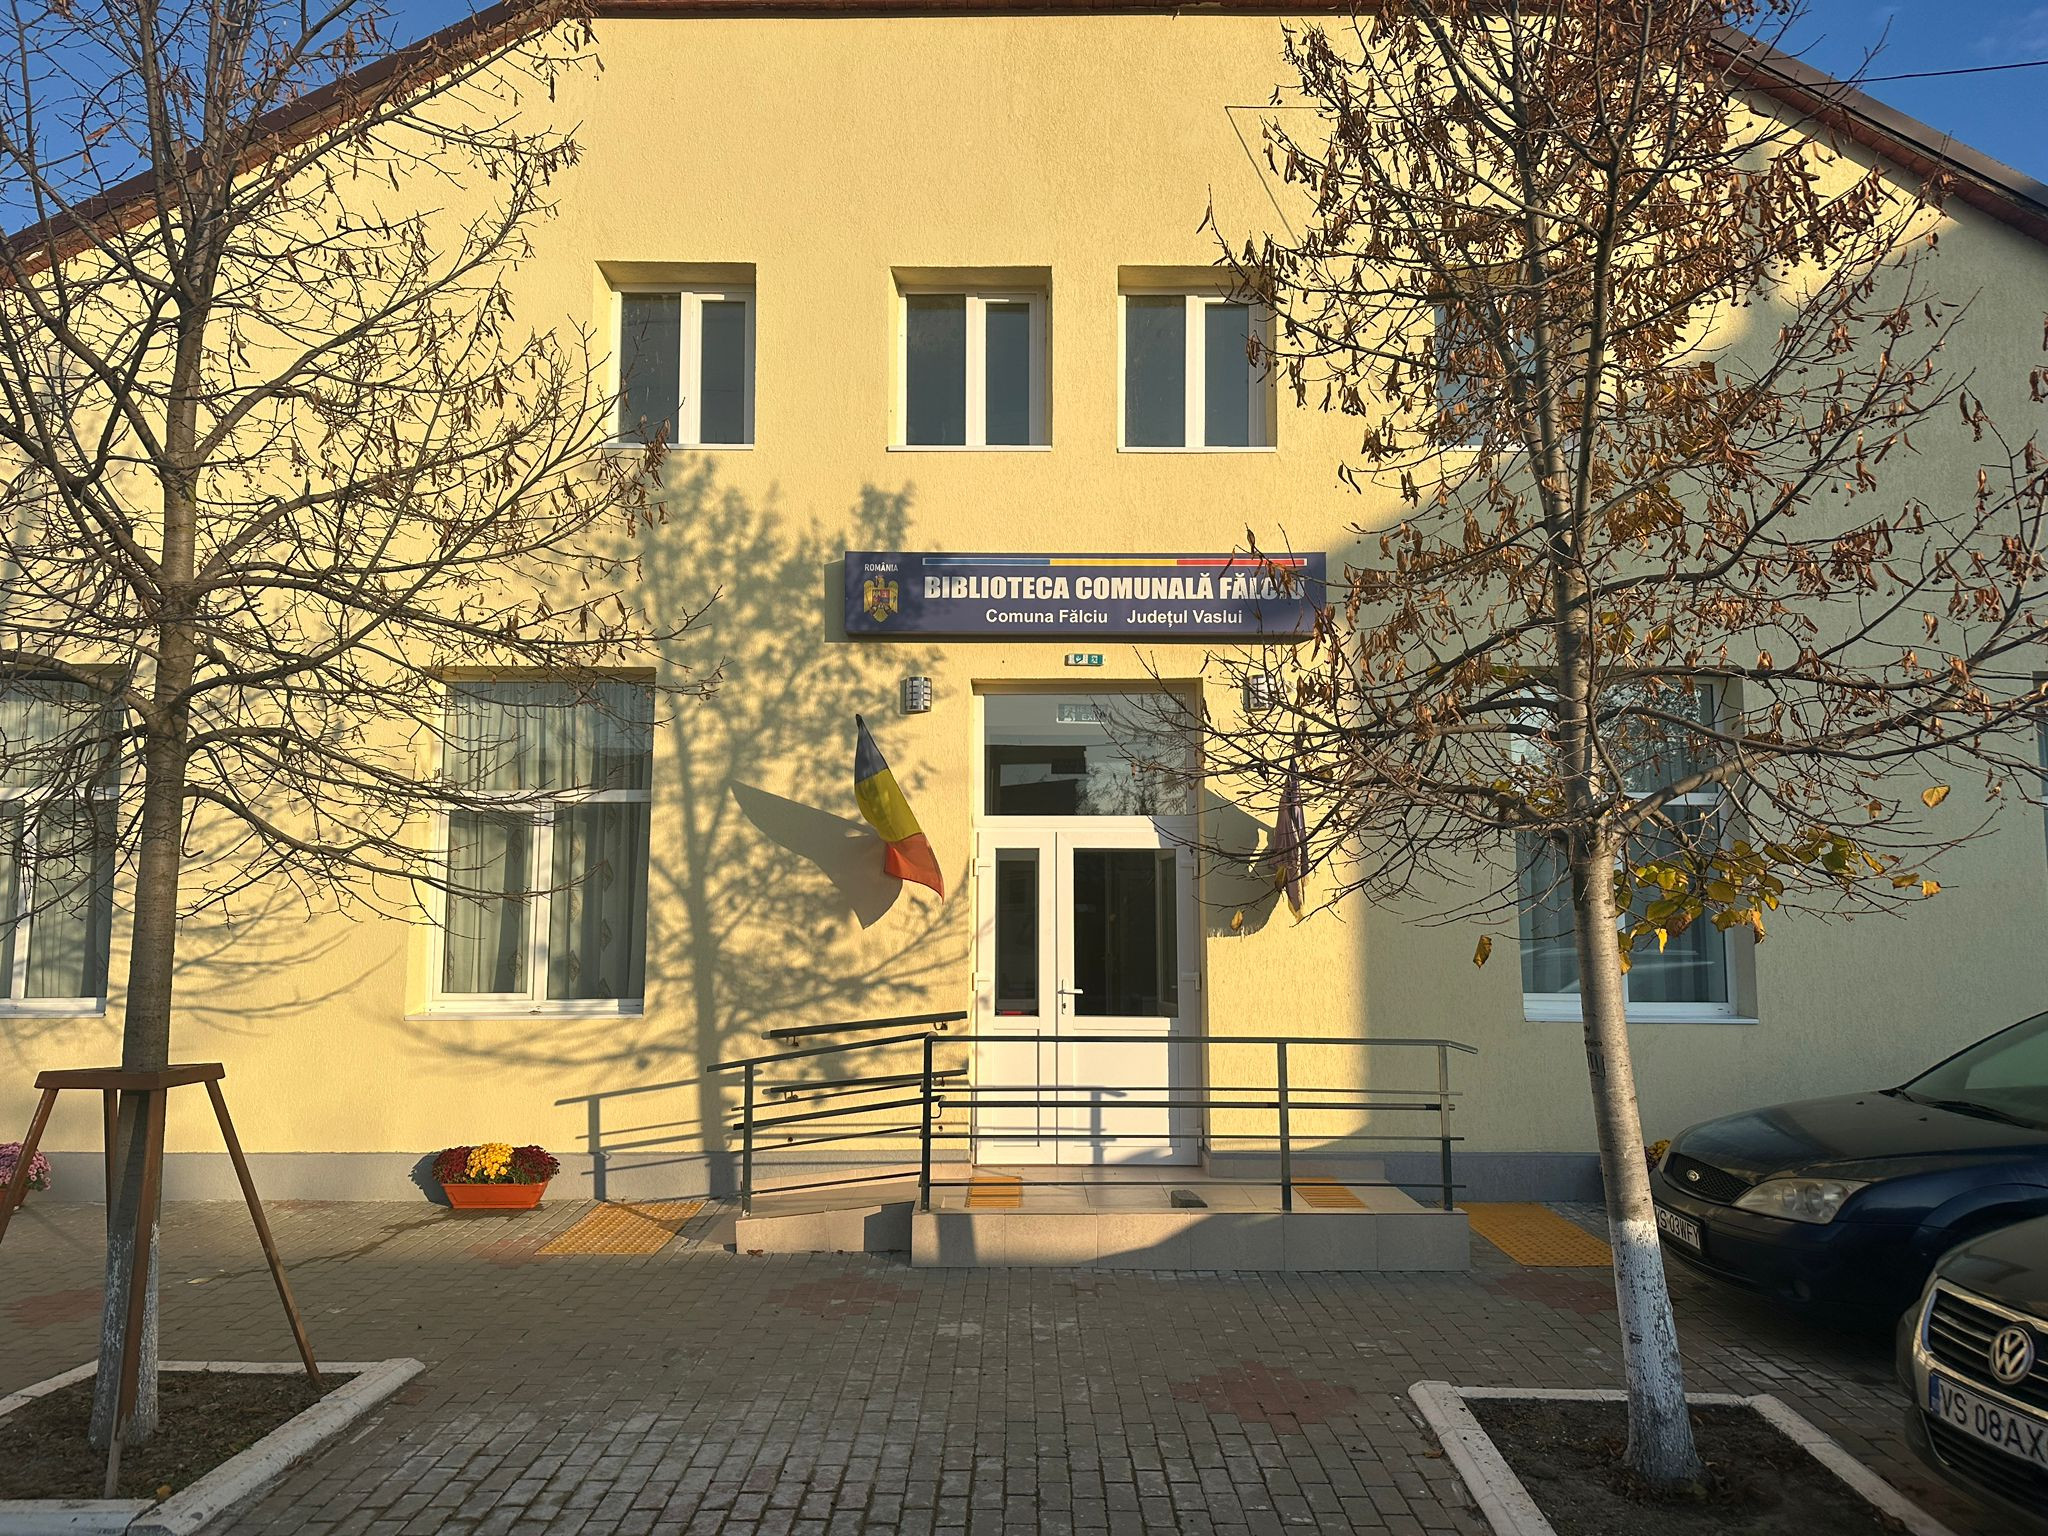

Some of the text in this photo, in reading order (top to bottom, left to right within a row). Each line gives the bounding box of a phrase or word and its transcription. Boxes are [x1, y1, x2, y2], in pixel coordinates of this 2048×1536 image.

[864, 562, 899, 572] ROMÂNIA
[924, 576, 1070, 600] BIBLIOTECA
[1075, 571, 1214, 600] COMUNALĂ
[985, 608, 1108, 624] Comuna Fălciu
[1126, 608, 1243, 628] Județul Vaslui
[1940, 1384, 1967, 1425] VS
